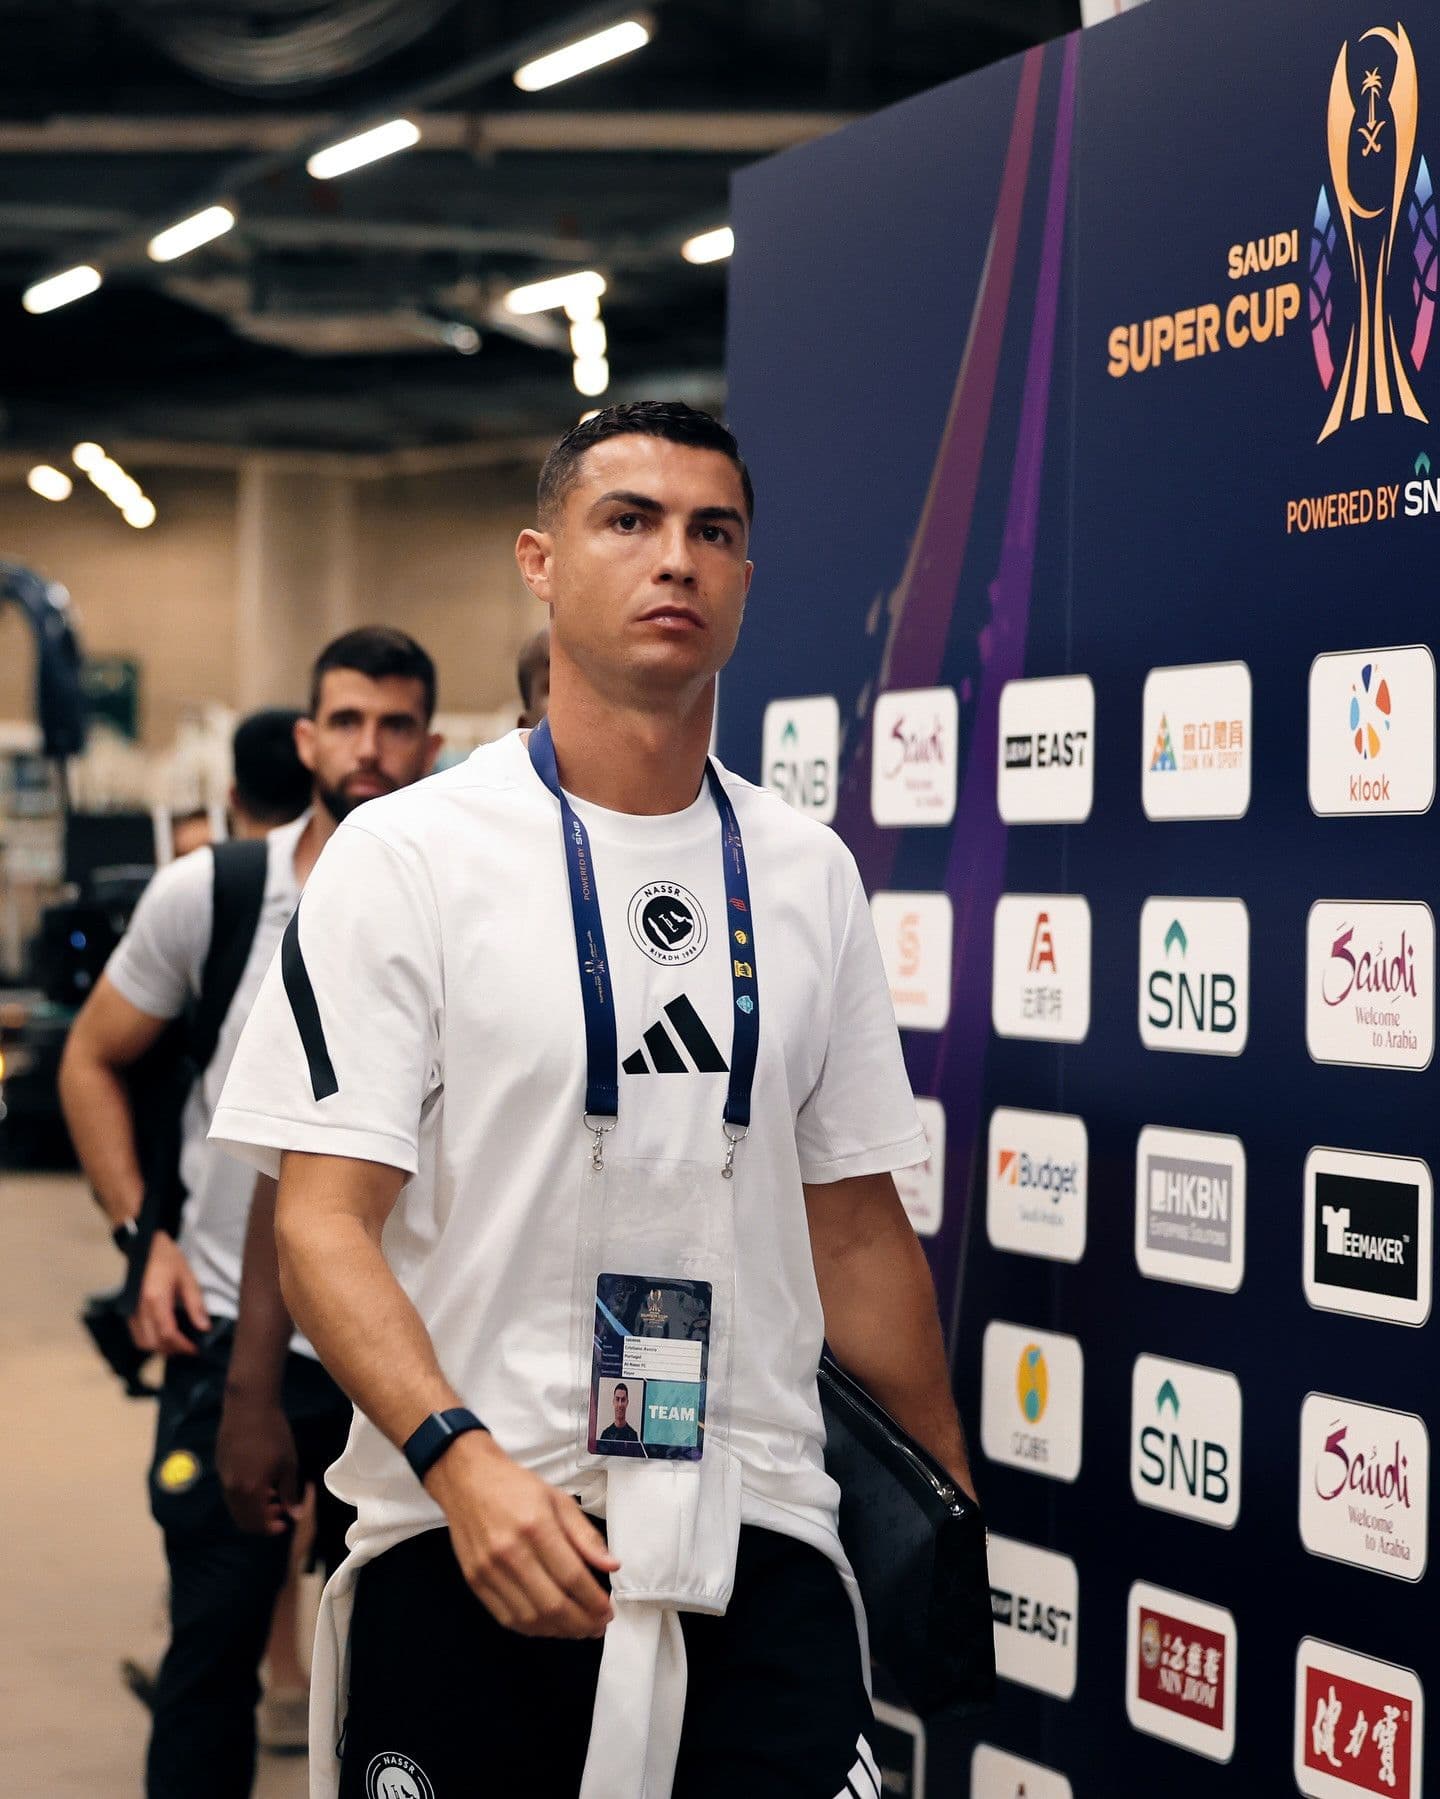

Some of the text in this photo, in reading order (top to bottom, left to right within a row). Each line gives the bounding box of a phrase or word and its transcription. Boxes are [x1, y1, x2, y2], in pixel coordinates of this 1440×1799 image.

[1228, 229, 1298, 279] SAUDI
[1107, 282, 1300, 378] SUPER CUP
[1287, 489, 1373, 534] POWERED
[1377, 484, 1399, 521] BY
[1037, 731, 1087, 768] EAST
[1349, 774, 1390, 801] klook
[578, 847, 585, 856] BY
[578, 857, 590, 901] POWERED
[644, 885, 681, 898] NASSR
[649, 947, 680, 961] RIYADH
[1322, 922, 1417, 1007] Saudi
[1148, 969, 1237, 1034] SNB
[1355, 1006, 1401, 1027] Welcome
[1372, 1029, 1418, 1050] to Arabia
[1167, 1170, 1228, 1222] HKBN
[649, 1405, 695, 1422] TEAM
[1140, 1426, 1230, 1504] SNB
[1315, 1419, 1411, 1508] Saudi
[1348, 1504, 1394, 1534] Welcome
[1017, 1597, 1072, 1646] EAST
[383, 1756, 416, 1774] NASSR
